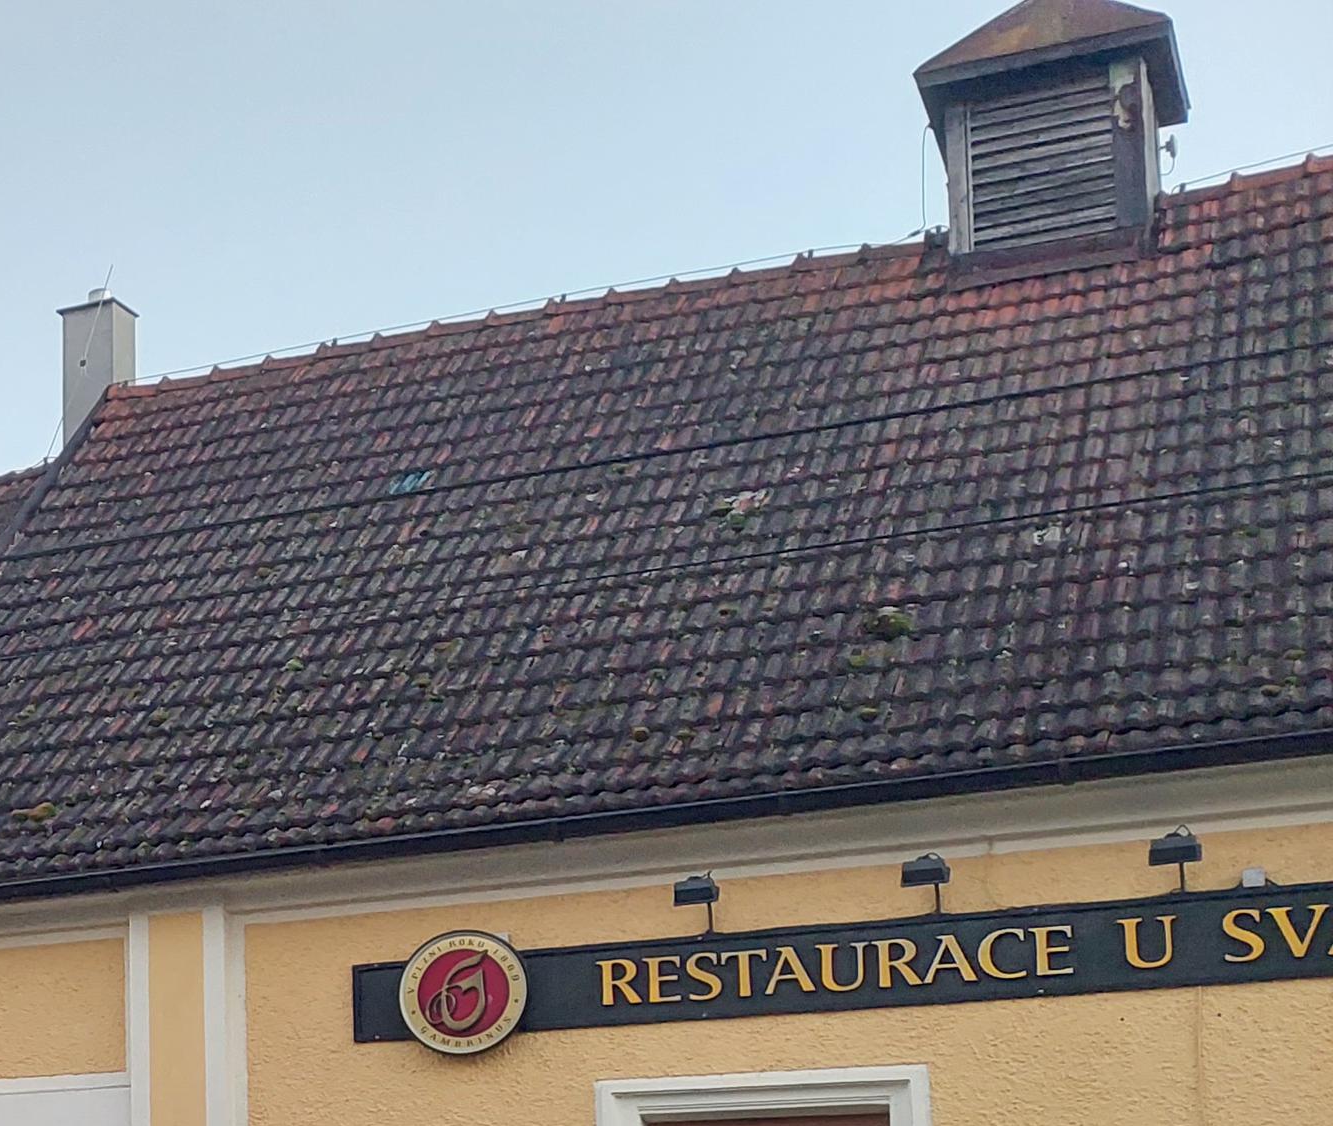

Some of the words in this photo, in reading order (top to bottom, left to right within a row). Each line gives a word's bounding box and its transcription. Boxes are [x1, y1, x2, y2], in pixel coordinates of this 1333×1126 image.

[596, 924, 1074, 1006] RESTAURACE
[1116, 914, 1177, 970] U
[420, 1014, 513, 1048] GAMBRINUS
